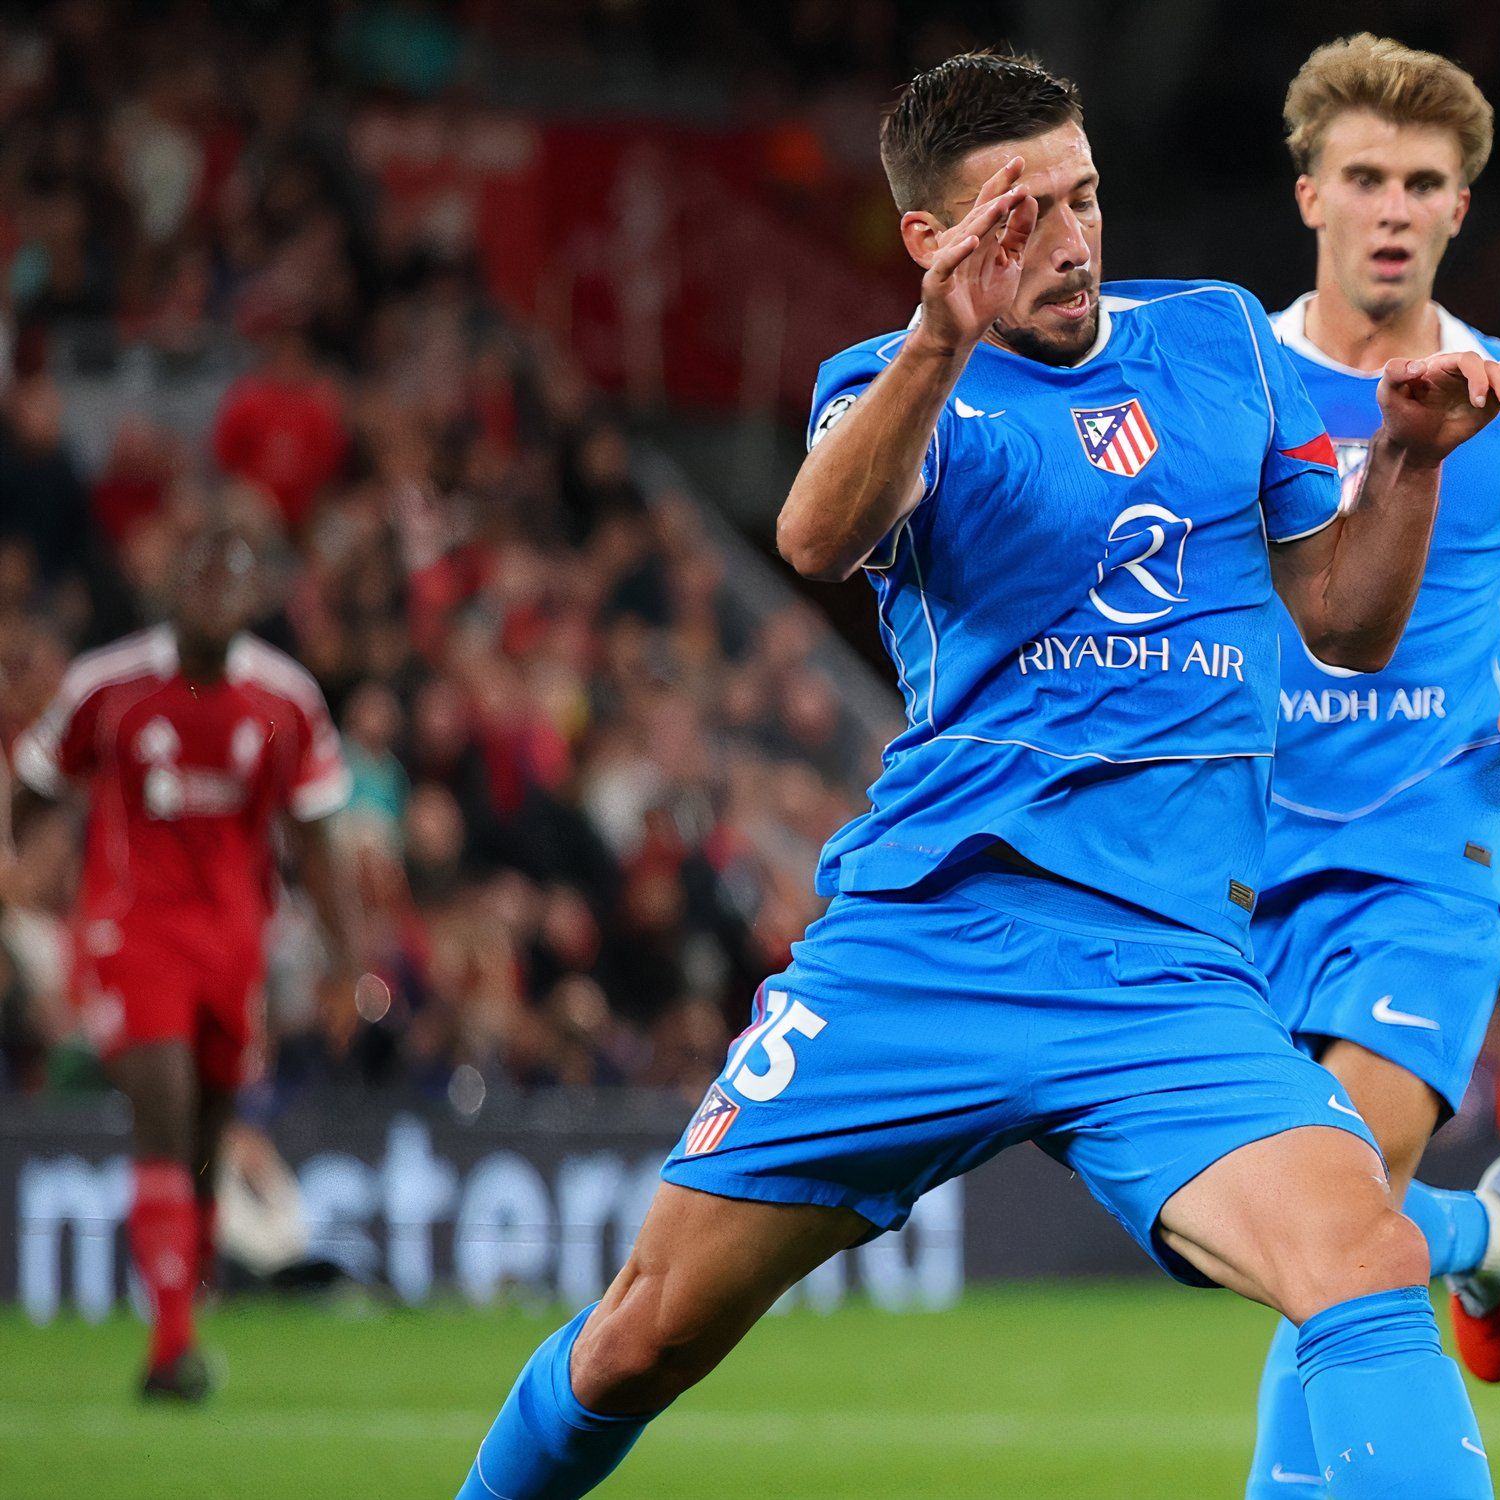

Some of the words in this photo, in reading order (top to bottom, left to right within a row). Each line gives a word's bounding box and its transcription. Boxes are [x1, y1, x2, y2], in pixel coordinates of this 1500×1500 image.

[1018, 636, 1169, 675] RIYADH
[1182, 641, 1244, 682] AIR
[1279, 688, 1378, 723] YADH
[1387, 686, 1447, 721] AIR
[725, 990, 829, 1102] 15
